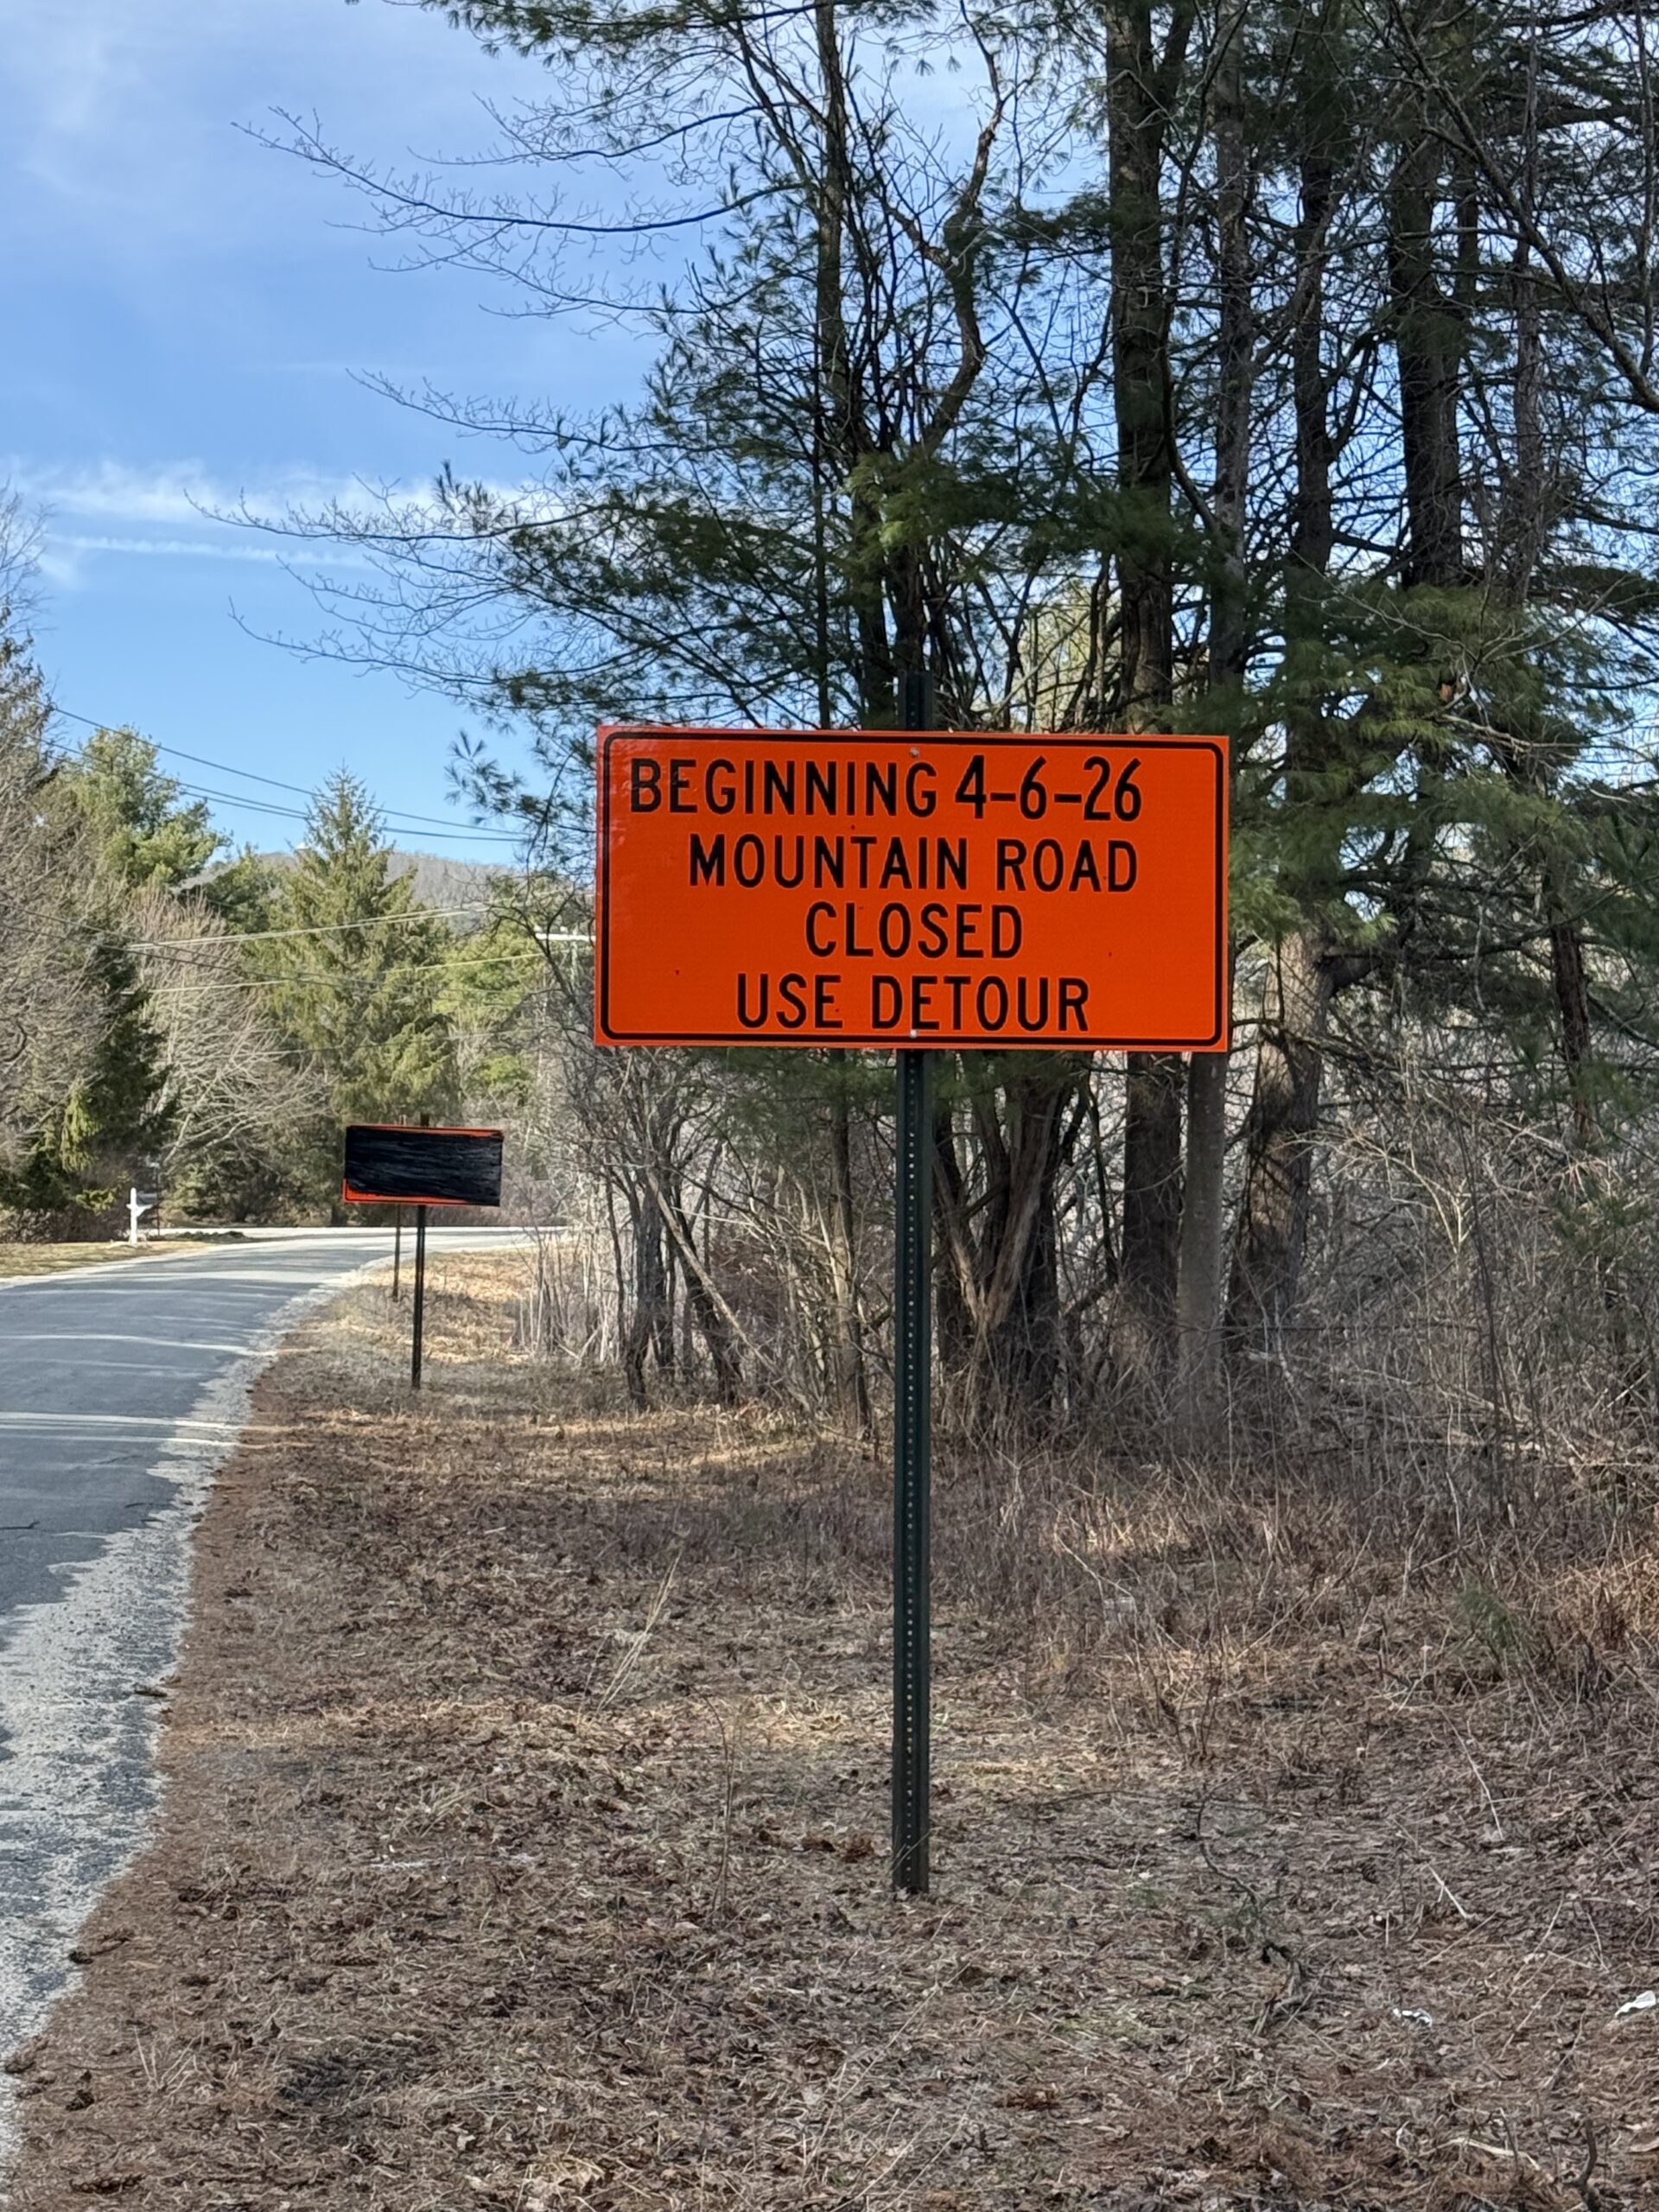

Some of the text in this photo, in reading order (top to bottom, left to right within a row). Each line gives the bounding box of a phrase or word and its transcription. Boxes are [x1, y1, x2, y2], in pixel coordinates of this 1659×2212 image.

[630, 754, 1142, 822] BEGINNING 4-6-26
[690, 833, 1137, 893] MOUNTAIN ROAD
[805, 901, 1022, 959] CLOSED
[737, 973, 1090, 1032] USE DETOUR
